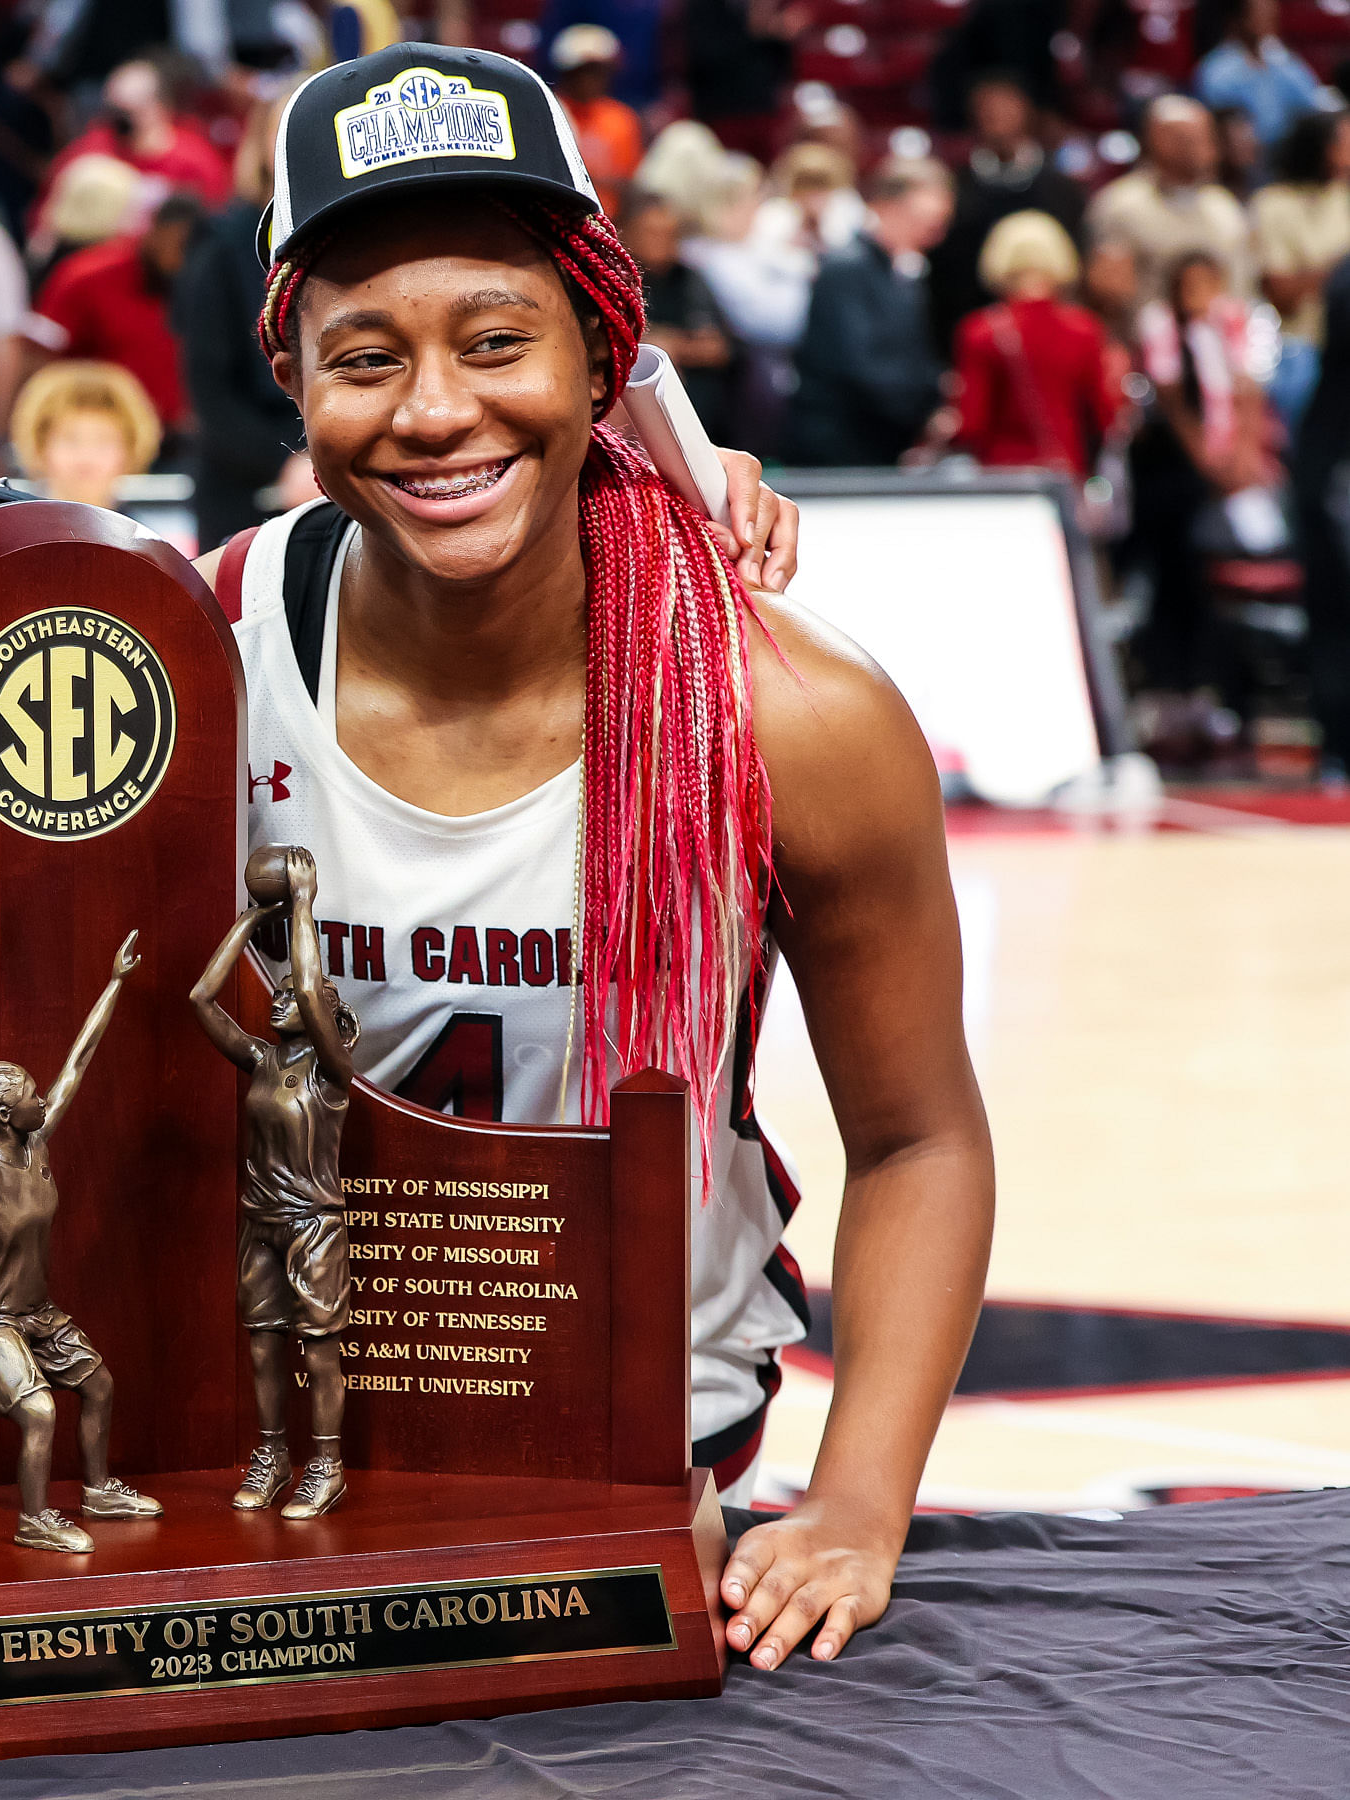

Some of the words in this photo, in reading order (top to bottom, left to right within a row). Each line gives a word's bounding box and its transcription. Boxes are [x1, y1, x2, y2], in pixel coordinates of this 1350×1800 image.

[374, 90, 391, 106] 20
[401, 76, 440, 110] SEC
[449, 83, 466, 95] 23
[347, 102, 503, 161] CHAMPIONS
[364, 146, 418, 167] WOMEN'S
[423, 143, 496, 152] BASKETBALL
[411, 926, 585, 988] CAROL
[340, 1178, 397, 1194] RSITY
[402, 1179, 429, 1195] OF
[434, 1180, 549, 1200] MISSISSIPPI
[385, 1212, 444, 1229] STATE
[449, 1213, 566, 1233] UNIVERSITY
[348, 1244, 406, 1260] RSITY
[411, 1245, 438, 1262] OF
[443, 1246, 539, 1265] MISSOURI
[372, 1276, 399, 1293] OF
[404, 1278, 473, 1296] SOUTH
[478, 1281, 579, 1300] CAROLINA
[403, 1311, 430, 1327] OF
[435, 1312, 547, 1332] TENNESSEE
[365, 1342, 411, 1359] A&M
[415, 1344, 532, 1364] UNIVERSITY
[294, 1372, 413, 1392] VERBILT
[418, 1377, 535, 1397] UNIVERSITY
[163, 1615, 217, 1649] OF
[230, 1603, 371, 1644] SOUTH
[384, 1586, 590, 1631] CAROLINA
[150, 1653, 213, 1679] 2023
[221, 1642, 355, 1674] CHAMPION
